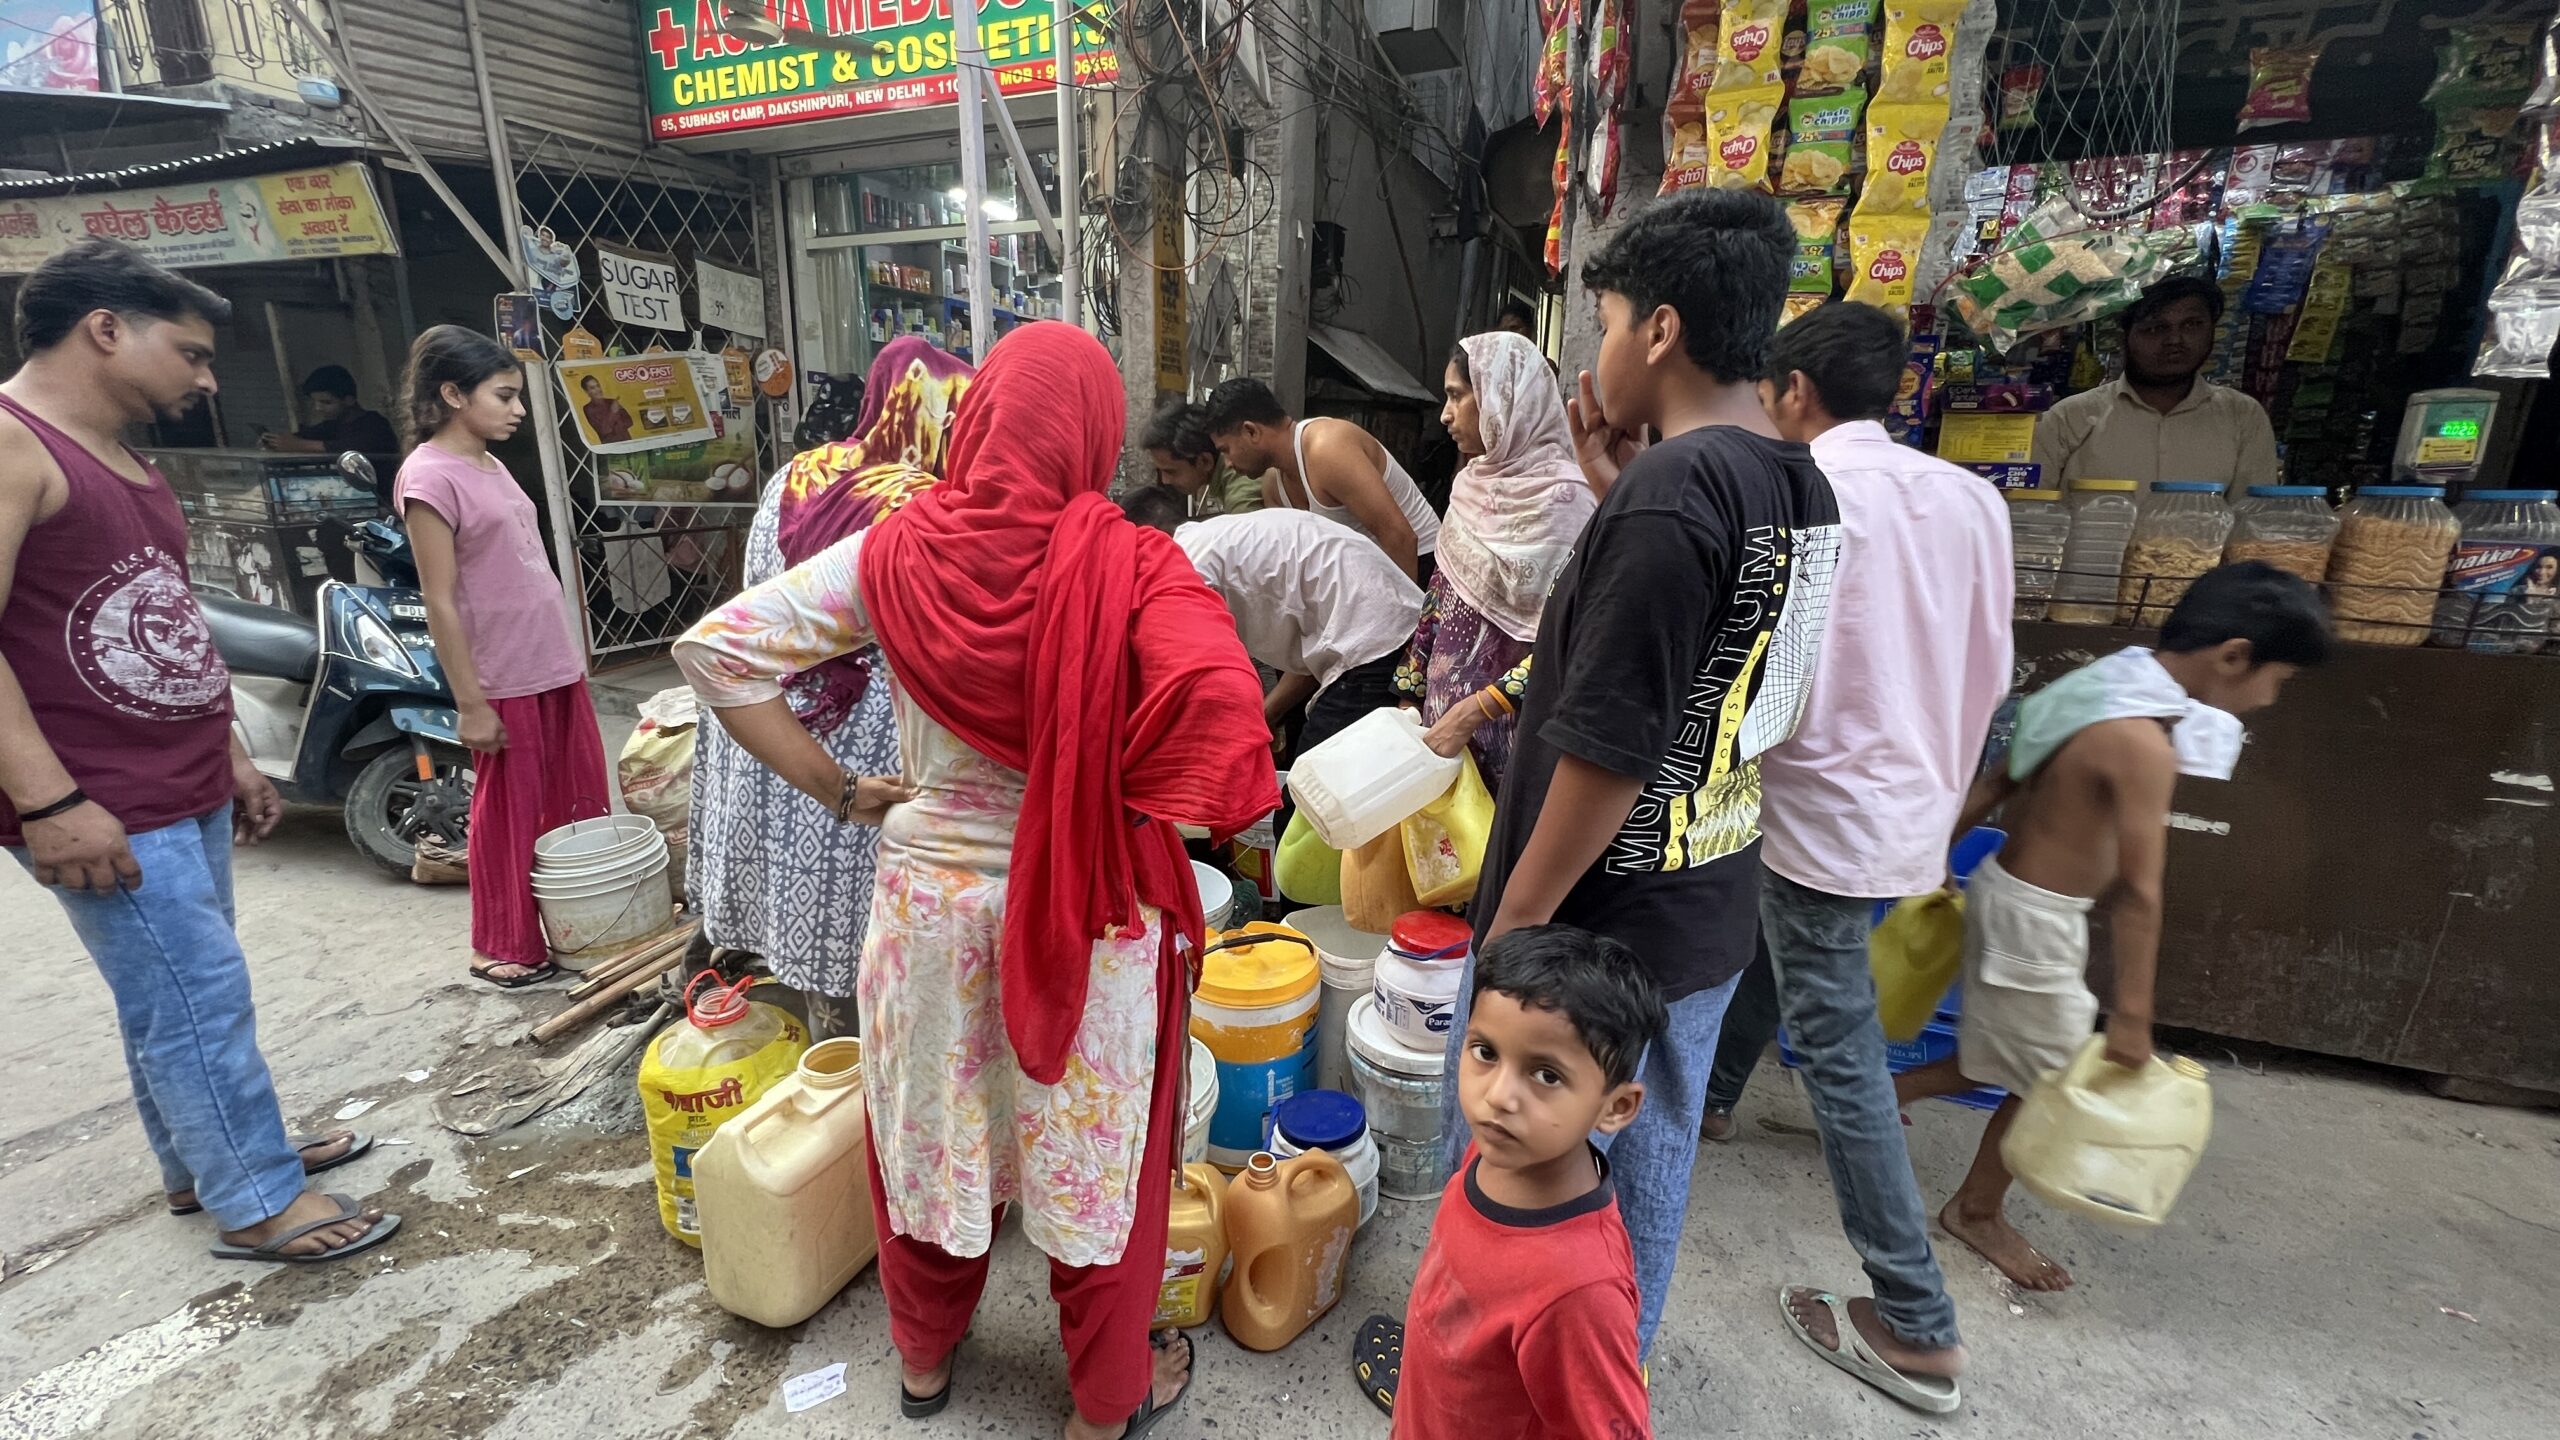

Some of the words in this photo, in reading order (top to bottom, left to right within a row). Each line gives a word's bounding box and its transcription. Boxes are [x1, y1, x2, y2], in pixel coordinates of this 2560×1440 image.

[1732, 29, 1768, 47] Chips
[1907, 39, 1945, 56] Chips
[673, 52, 819, 106] CHEMIST
[831, 50, 860, 83] &
[1000, 68, 1033, 86] MOB
[661, 118, 678, 132] 95,
[679, 109, 730, 129] SUBHASH
[732, 105, 765, 121] CAMP,
[768, 94, 853, 117] DAKSHINPURI,
[855, 88, 884, 105] NEW
[888, 84, 926, 100] DELHI
[1722, 138, 1756, 157] Chips
[1888, 154, 1924, 171] Chips
[600, 257, 680, 296] SUGAR
[1870, 263, 1905, 280] Chips
[615, 291, 670, 322] TEST
[409, 606, 426, 617] DL
[1605, 525, 1776, 875] MOMENTUM
